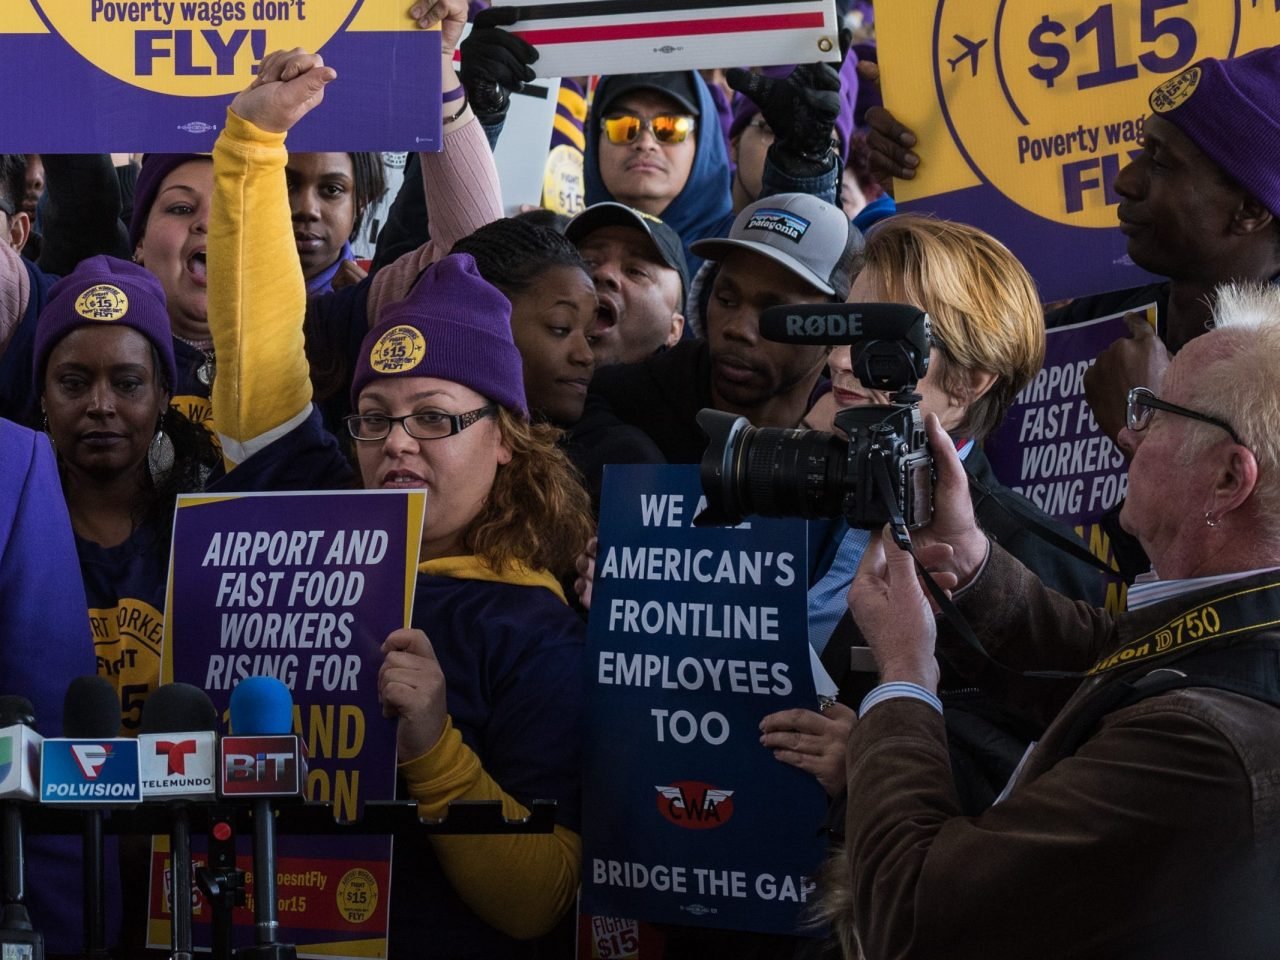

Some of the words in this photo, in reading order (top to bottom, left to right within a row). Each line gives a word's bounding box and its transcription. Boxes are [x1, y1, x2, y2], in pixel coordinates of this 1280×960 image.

[180, 0, 246, 26] wages
[134, 29, 267, 76] FLY!
[1017, 124, 1100, 165] Poverty
[747, 216, 805, 240] patagonia
[786, 313, 864, 337] RØDE
[1019, 401, 1074, 443] FAST
[1021, 437, 1125, 481] WORKERS
[640, 494, 685, 528] WE
[202, 529, 325, 567] AIRPORT
[324, 529, 389, 565] AND
[601, 546, 796, 588] AMERICAN'S
[216, 571, 285, 608] FAST
[288, 570, 366, 607] FOOD
[220, 612, 354, 649] WORKERS
[608, 599, 780, 641] FRONTLINE
[1155, 606, 1221, 652] D750
[205, 654, 298, 691] RISING
[305, 653, 362, 691] FOR
[598, 650, 794, 697] EMPLOYEES
[651, 708, 731, 746] TOO
[45, 783, 137, 798] POLVISION
[142, 777, 212, 789] TELEMUNDO
[668, 785, 721, 823] CWA
[593, 858, 687, 893] BRIDGE
[693, 868, 747, 898] THE
[347, 891, 367, 904] $15
[597, 928, 639, 959] $15
